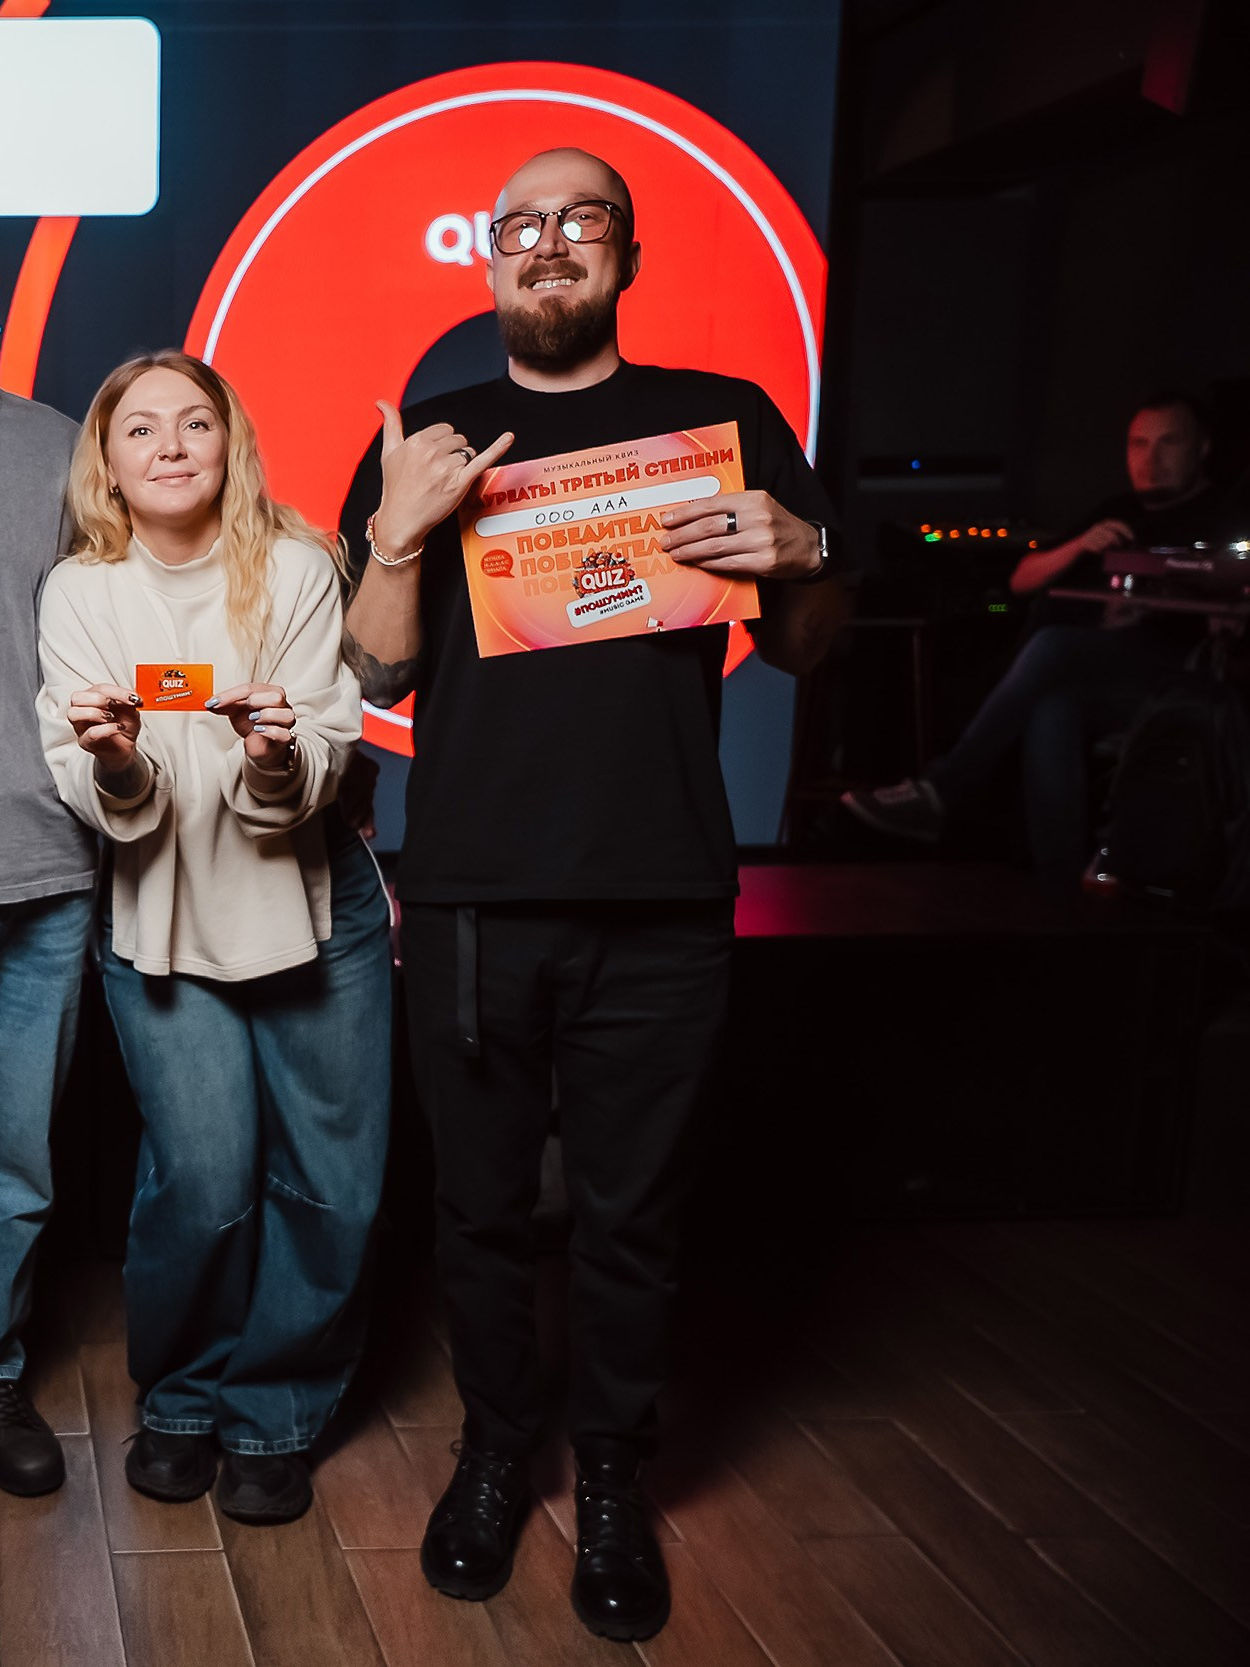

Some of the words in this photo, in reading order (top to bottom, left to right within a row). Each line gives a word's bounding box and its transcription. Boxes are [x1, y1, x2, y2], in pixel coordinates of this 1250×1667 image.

[425, 210, 494, 266] QU
[543, 452, 612, 473] МУЗЫКАЛЬНЫЙ
[615, 449, 639, 460] КВИЗ
[482, 482, 556, 507] УРЕАТЫ
[560, 462, 640, 493] ТРЕТЬЕЙ
[644, 447, 734, 477] СТЕПЕНИ
[516, 512, 667, 554] ПОБЕДИТЕЛ
[581, 568, 625, 590] QUIZ
[574, 584, 643, 616] #ПОШУМИМ?
[625, 594, 644, 606] GAME
[162, 680, 183, 688] QUIZ
